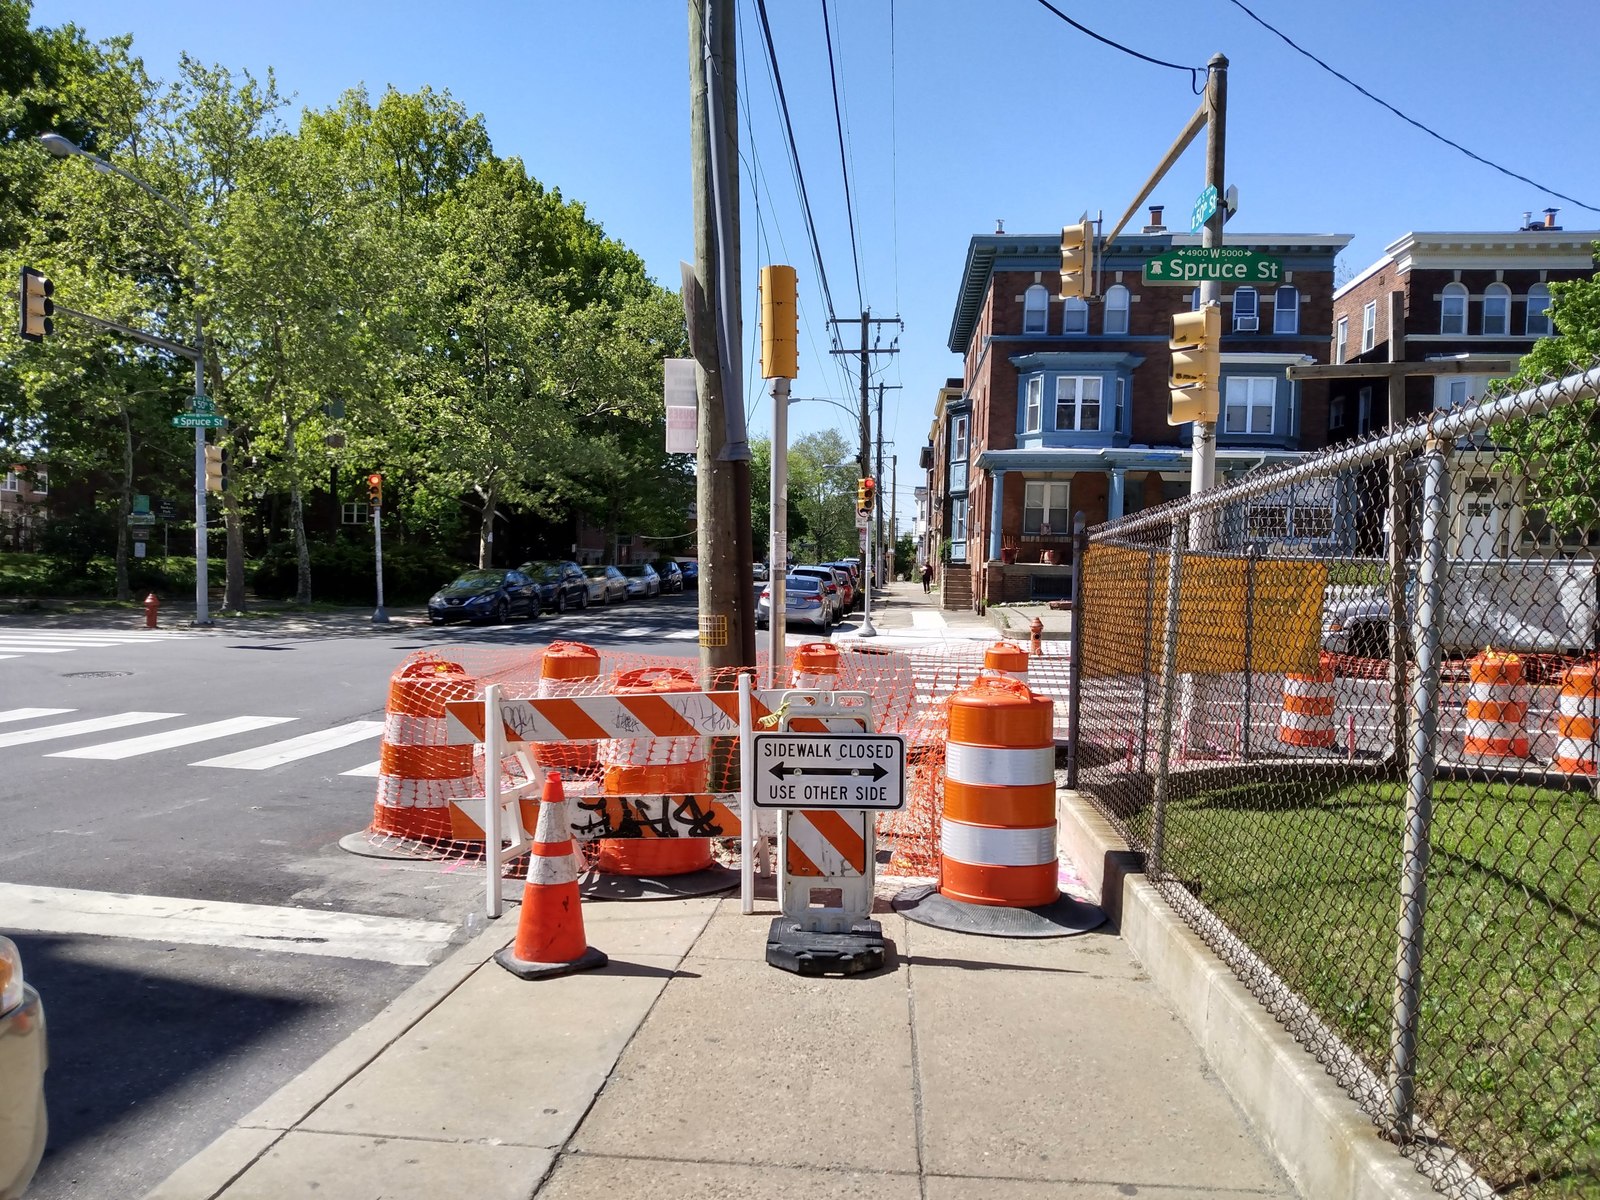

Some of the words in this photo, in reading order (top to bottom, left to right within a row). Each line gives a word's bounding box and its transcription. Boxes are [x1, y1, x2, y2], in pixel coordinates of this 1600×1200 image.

[1209, 193, 1217, 214] St
[1187, 249, 1209, 257] 4900
[1210, 248, 1220, 258] W
[1221, 249, 1244, 257] 5000
[1169, 259, 1248, 280] Spruce
[1257, 261, 1278, 279] St
[180, 417, 211, 427] Spruce
[214, 418, 223, 426] St
[764, 743, 832, 758] SIDEWALK
[840, 744, 894, 759] CLOSED
[769, 785, 796, 800] USE
[804, 786, 848, 800] OTHER
[855, 786, 887, 801] SIDE
